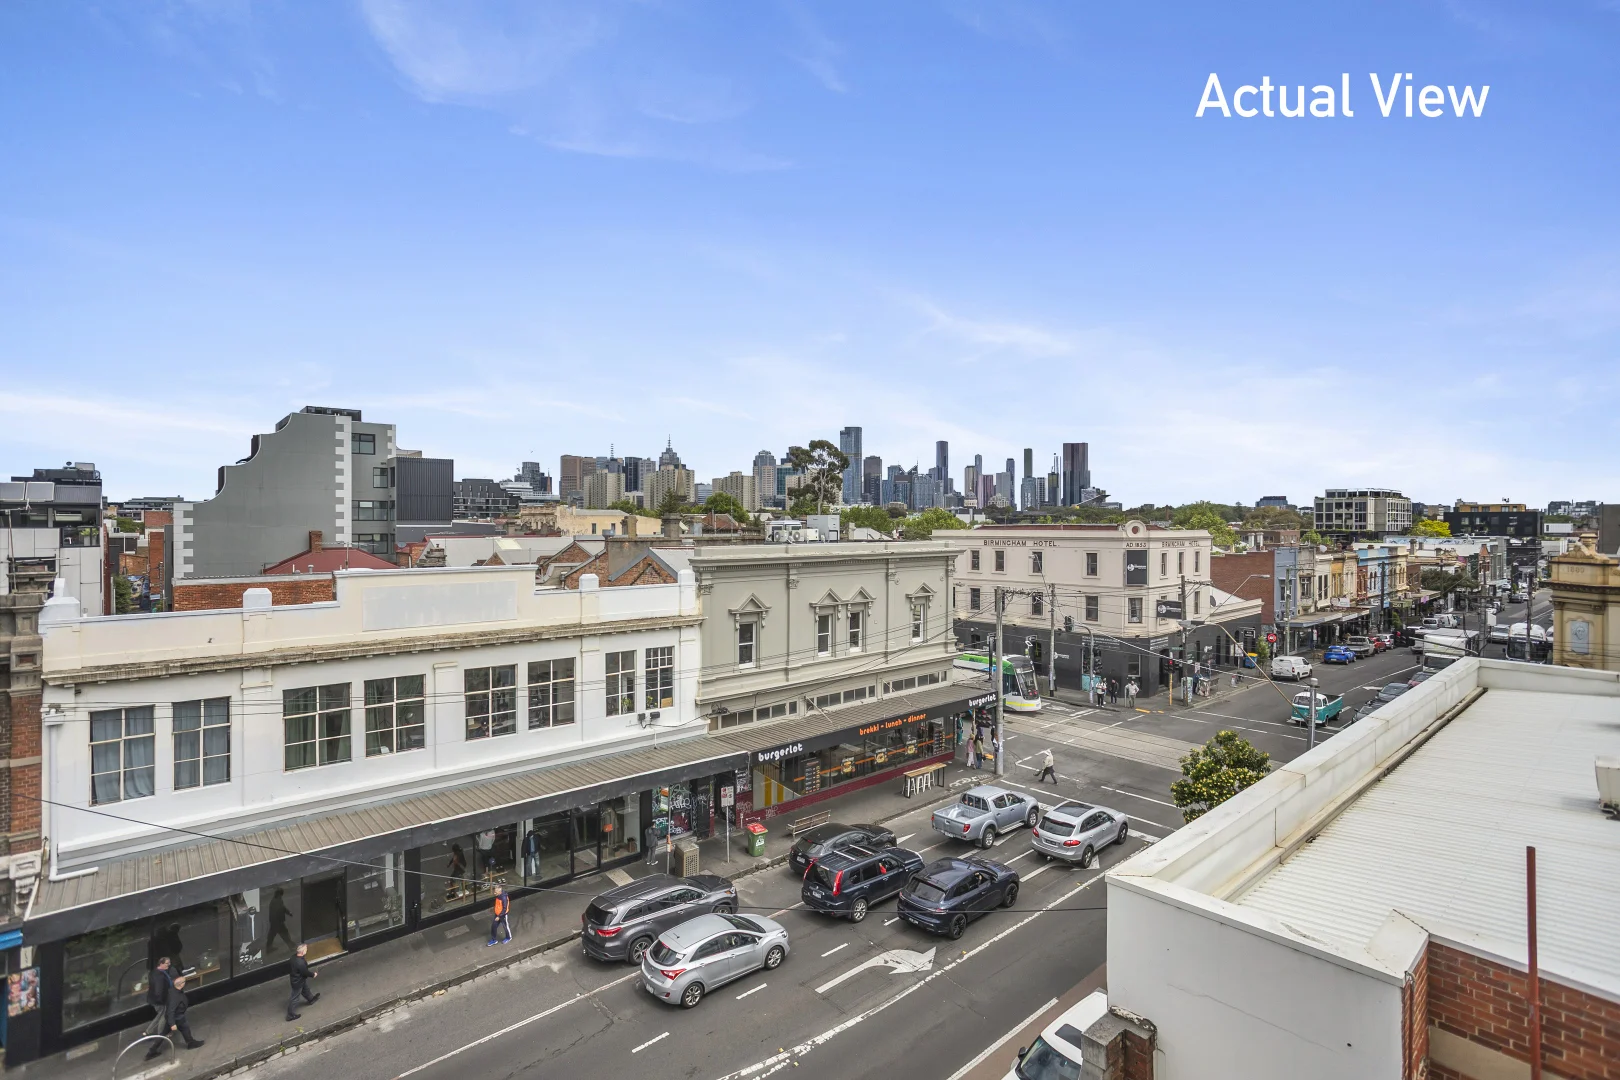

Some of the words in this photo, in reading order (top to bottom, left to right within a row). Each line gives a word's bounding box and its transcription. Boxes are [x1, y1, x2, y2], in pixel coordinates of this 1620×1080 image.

[983, 539, 1027, 547] BIRMINGHAM
[968, 693, 997, 707] burgerlot
[885, 718, 903, 729] lunch
[907, 713, 927, 723] dinner
[758, 743, 803, 762] burgerlot
